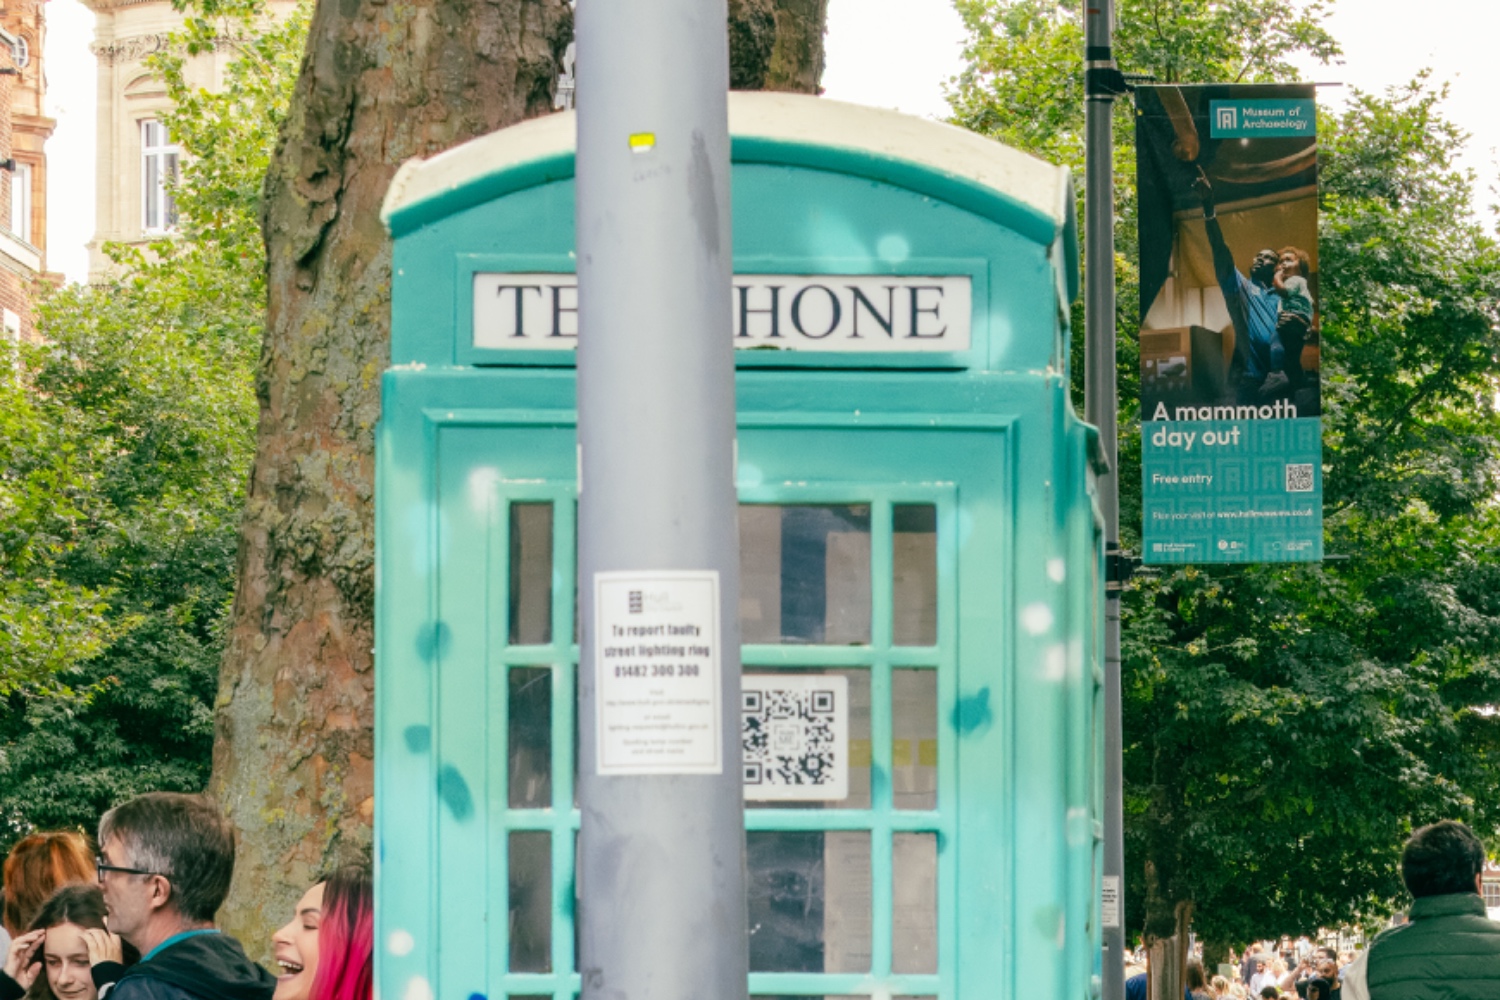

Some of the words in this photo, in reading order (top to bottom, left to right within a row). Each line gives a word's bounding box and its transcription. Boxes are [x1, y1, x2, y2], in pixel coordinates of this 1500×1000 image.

[1242, 107, 1285, 117] Museum
[1288, 106, 1302, 116] of
[1242, 119, 1308, 130] Archaeology
[497, 284, 948, 340] TEHONE
[1152, 401, 1171, 421] A
[1175, 398, 1298, 421] mammoth
[1152, 425, 1197, 451] day
[1202, 425, 1241, 446] out
[1152, 473, 1179, 485] Free
[1181, 473, 1214, 486] entry
[612, 624, 624, 637] To
[627, 625, 665, 638] report
[668, 624, 701, 638] faulty
[604, 646, 636, 658] street
[639, 645, 686, 658] lighting
[688, 646, 710, 658] ring
